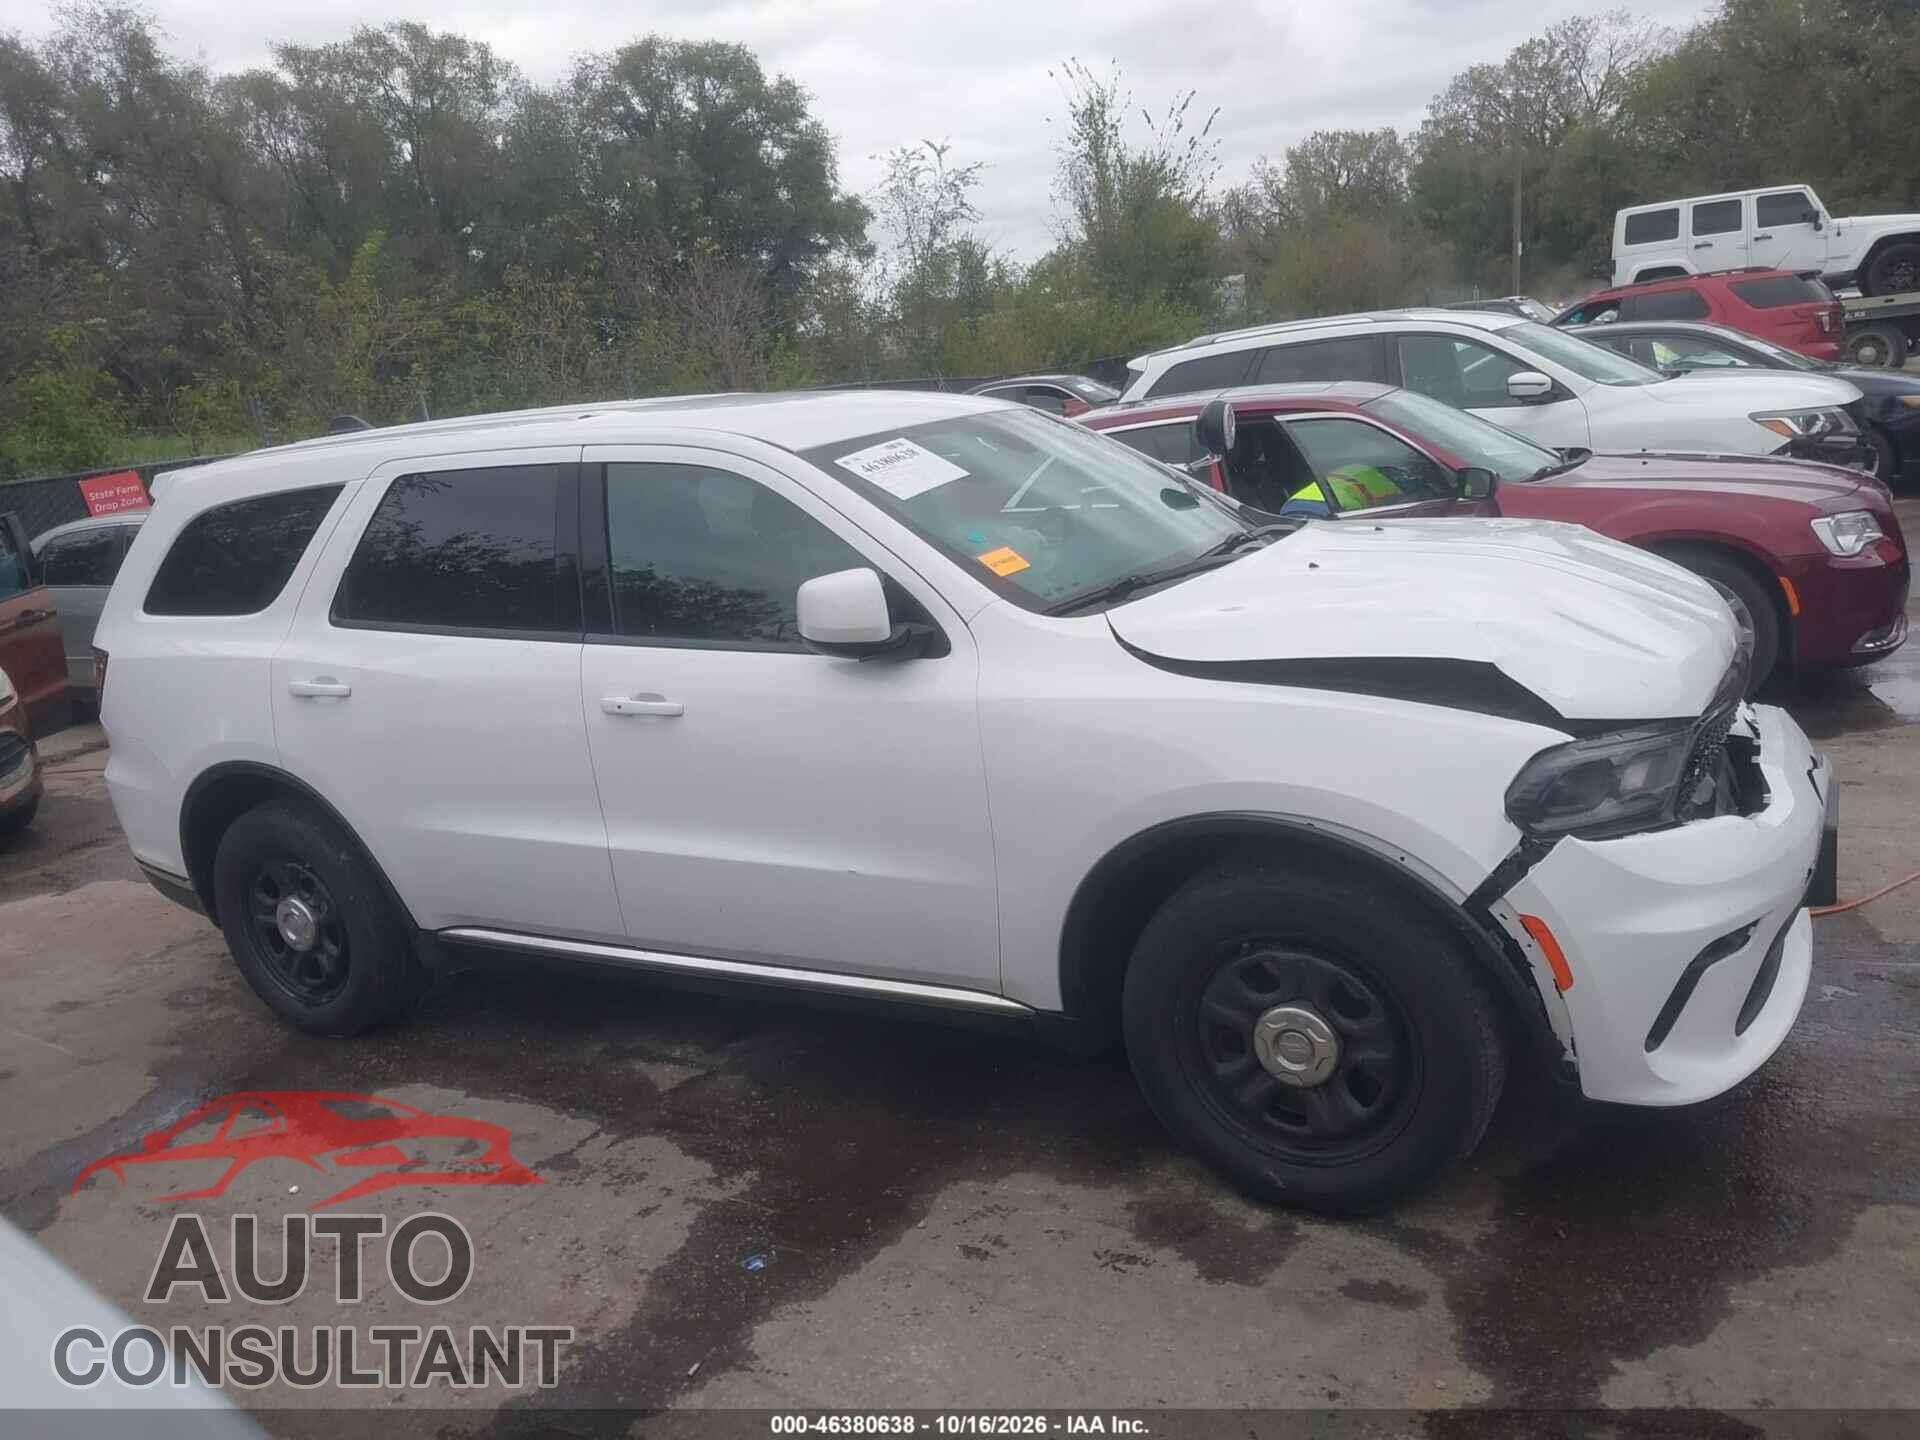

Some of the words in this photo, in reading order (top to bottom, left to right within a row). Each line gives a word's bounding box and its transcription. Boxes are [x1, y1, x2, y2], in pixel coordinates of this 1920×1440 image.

[88, 489, 115, 502] State
[116, 485, 140, 496] Farm
[95, 501, 119, 513] Drop
[120, 496, 144, 507] Zone
